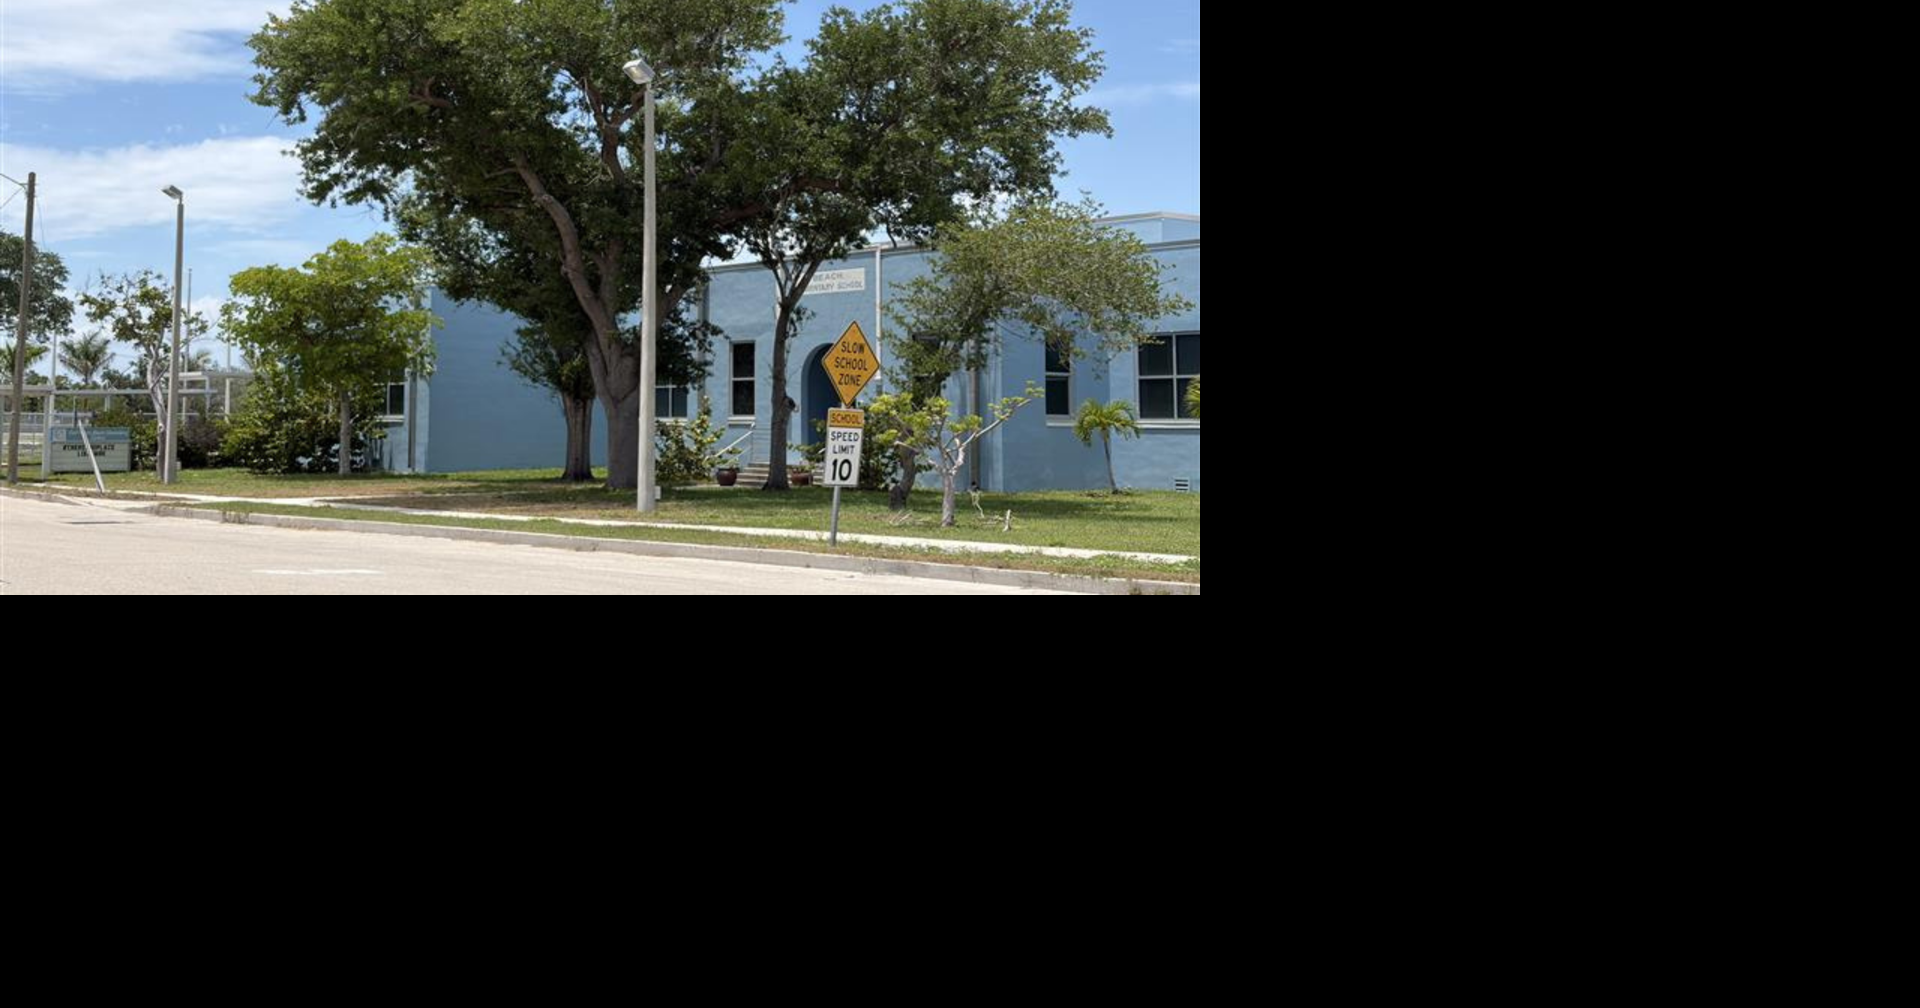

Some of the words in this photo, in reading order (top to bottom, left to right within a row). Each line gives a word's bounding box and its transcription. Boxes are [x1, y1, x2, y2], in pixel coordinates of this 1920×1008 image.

[841, 341, 864, 354] SLOW
[834, 356, 868, 371] SCHOOL
[838, 373, 862, 387] ZONE
[831, 412, 862, 425] SCHOOL
[830, 430, 860, 442] SPEED
[832, 445, 855, 455] LIMIT
[832, 458, 852, 481] 10
